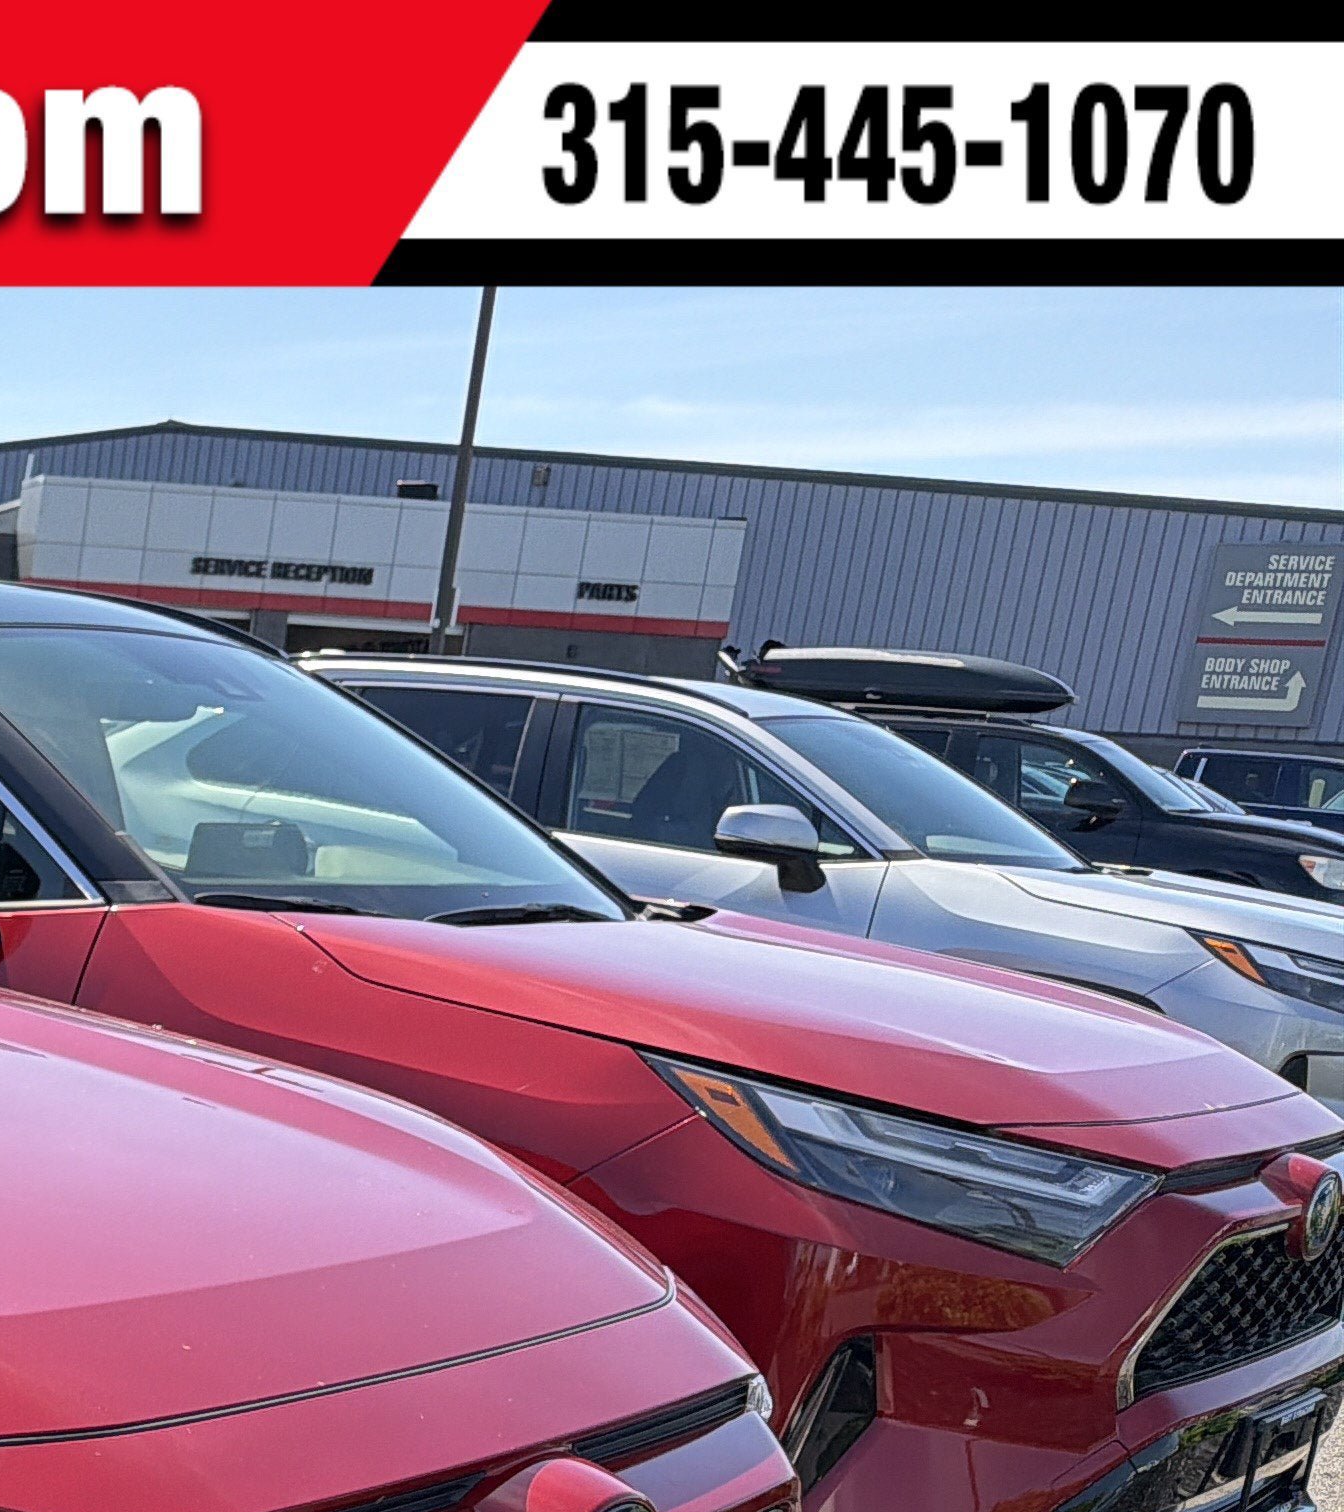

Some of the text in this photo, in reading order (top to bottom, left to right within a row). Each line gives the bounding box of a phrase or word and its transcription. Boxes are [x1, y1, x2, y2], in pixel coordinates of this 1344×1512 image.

[191, 556, 374, 586] SERVICE RECEPTION
[1268, 554, 1336, 571] SERVICE
[1224, 571, 1333, 589] DEPARTMENT
[577, 581, 639, 603] PARTS
[1241, 588, 1327, 606] ENTRANCE
[1204, 656, 1291, 674] BODY SHOP
[1200, 674, 1281, 691] ENTRANCE
